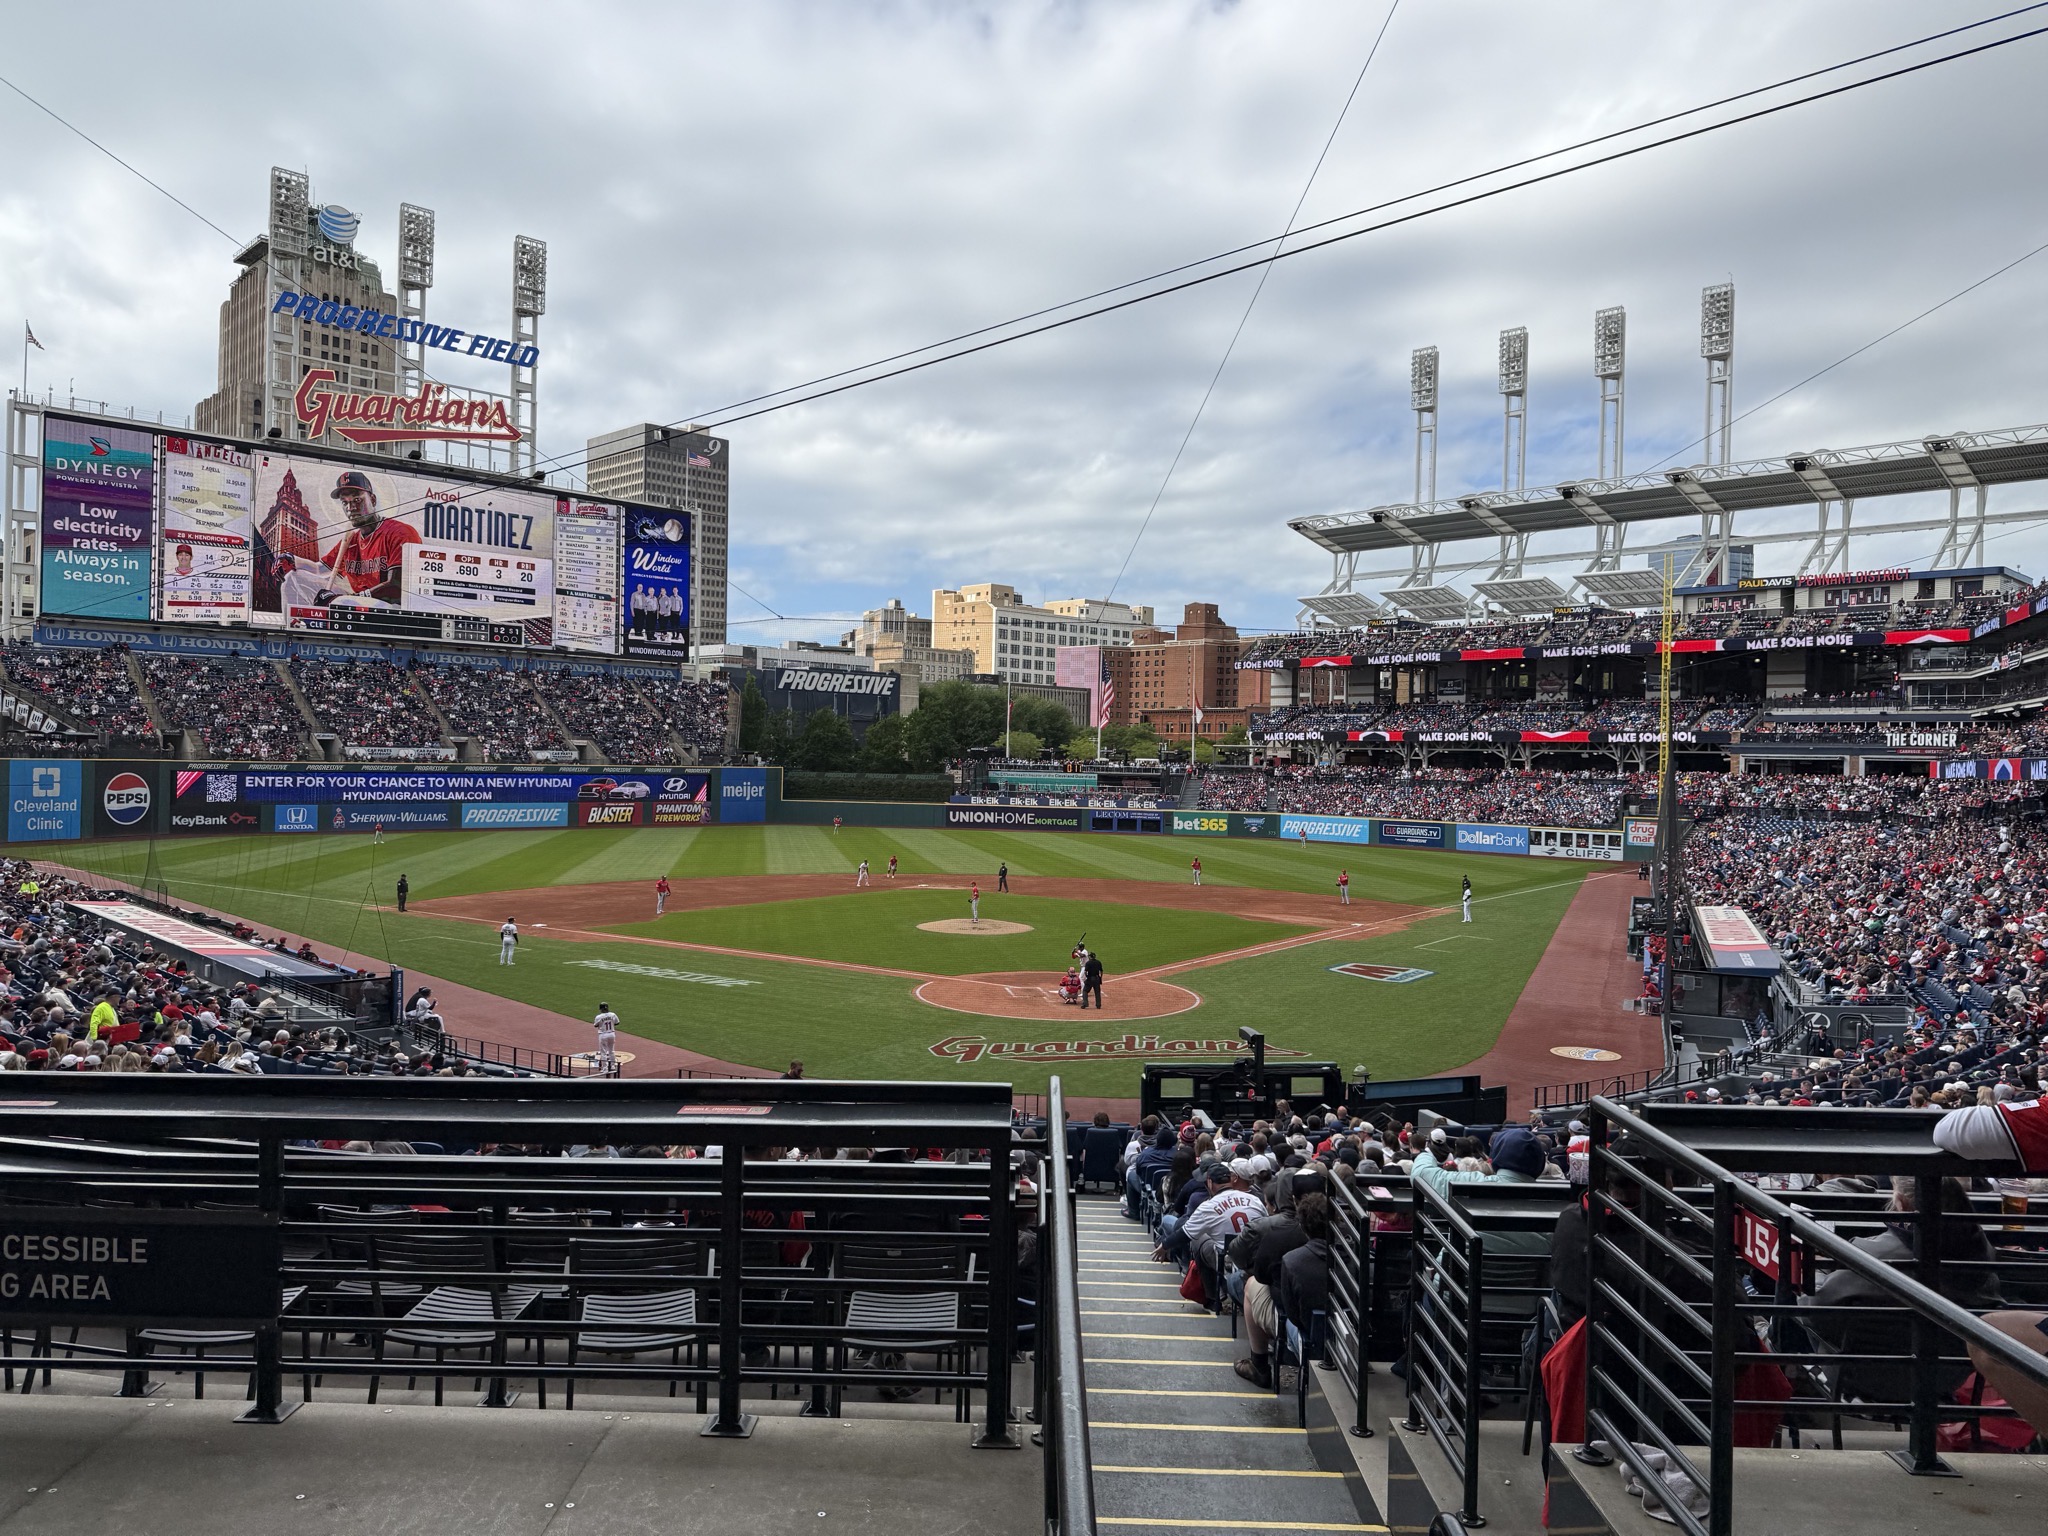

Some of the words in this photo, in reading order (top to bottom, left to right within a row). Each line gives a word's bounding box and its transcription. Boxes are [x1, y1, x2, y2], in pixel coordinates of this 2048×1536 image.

[313, 245, 362, 272] at&t
[271, 290, 465, 353] PROGRESSIVE
[466, 334, 540, 368] FIELD
[294, 368, 523, 444] Guardians
[196, 444, 241, 466] ANGELS
[56, 457, 141, 480] DYNEGY
[56, 474, 94, 484] POWERED
[111, 481, 138, 490] VISTRA
[425, 487, 460, 503] Angel
[80, 502, 117, 520] Low
[53, 516, 142, 541] electricity
[424, 501, 534, 550] MARTÍNEZ
[73, 538, 122, 552] rates.
[195, 533, 228, 543] HENDRICKS
[54, 549, 118, 570] Always
[123, 556, 139, 570] in
[632, 547, 682, 571] Window
[63, 569, 130, 585] season.
[421, 561, 443, 573] .268
[456, 565, 479, 577] .690
[496, 569, 502, 579] 3
[520, 572, 533, 583] 20
[1798, 573, 1853, 587] PENNANT
[1856, 568, 1911, 584] DISTRICT
[68, 630, 153, 645] HONDA
[179, 637, 258, 652] HONDA
[1746, 638, 1779, 650] MAKE
[1780, 637, 1813, 648] SOME
[1816, 634, 1853, 646] NOISE
[313, 646, 385, 659] HONDA
[629, 647, 684, 657] WINDOWWORLD.COM
[1367, 655, 1389, 665] MAKE
[1390, 654, 1414, 664] SOME
[1415, 652, 1441, 662] NOISE
[1542, 647, 1567, 658] MAKE
[1568, 646, 1598, 658] SOME
[1600, 644, 1632, 655] NOISE
[438, 654, 501, 667] HONDA
[549, 661, 605, 674] HONDA
[1243, 661, 1263, 669] SOME
[1263, 660, 1284, 668] NOISE
[623, 667, 675, 678] HONDA
[777, 669, 896, 696] PROGRESSIVE
[1264, 733, 1283, 741] MAKE
[1285, 733, 1304, 741] SOME
[1419, 733, 1442, 742] MAKE
[1444, 733, 1468, 742] SOME
[1608, 733, 1636, 742] MAKE
[1639, 733, 1667, 742] SOME
[1886, 733, 1906, 746] THE
[1909, 733, 1957, 747] CORNER
[245, 776, 294, 788] ENTER
[296, 777, 325, 788] FOR
[328, 777, 366, 788] YOUR
[369, 777, 426, 788] CHANCE
[428, 778, 444, 788] TO
[447, 778, 474, 787] WIN
[475, 778, 484, 787] A
[487, 778, 516, 787] NEW
[518, 778, 572, 788] HYUNDAI
[106, 793, 148, 805] PEPSI
[343, 791, 492, 801] HYUNDAIGRANDSLAM.COM
[723, 783, 765, 800] meijer
[14, 799, 77, 814] Cleveland
[655, 804, 702, 813] PHANTOM
[172, 815, 227, 827] KeyBank
[464, 808, 560, 823] PROGRESSIVE
[587, 806, 634, 824] BLASTER
[654, 813, 701, 823] FIREWORKS
[1095, 811, 1129, 819] LECOM
[27, 818, 64, 831] Clinic
[1173, 815, 1228, 832] bet365
[1283, 820, 1362, 837] PROGRESSIVE
[1630, 825, 1655, 836] drug
[1566, 848, 1611, 859] CLIFFS
[604, 1021, 612, 1030] 11
[1214, 1196, 1251, 1216] GIMÉNEZ
[3, 1234, 148, 1263] CESSIBLE
[29, 1273, 111, 1300] AREA
